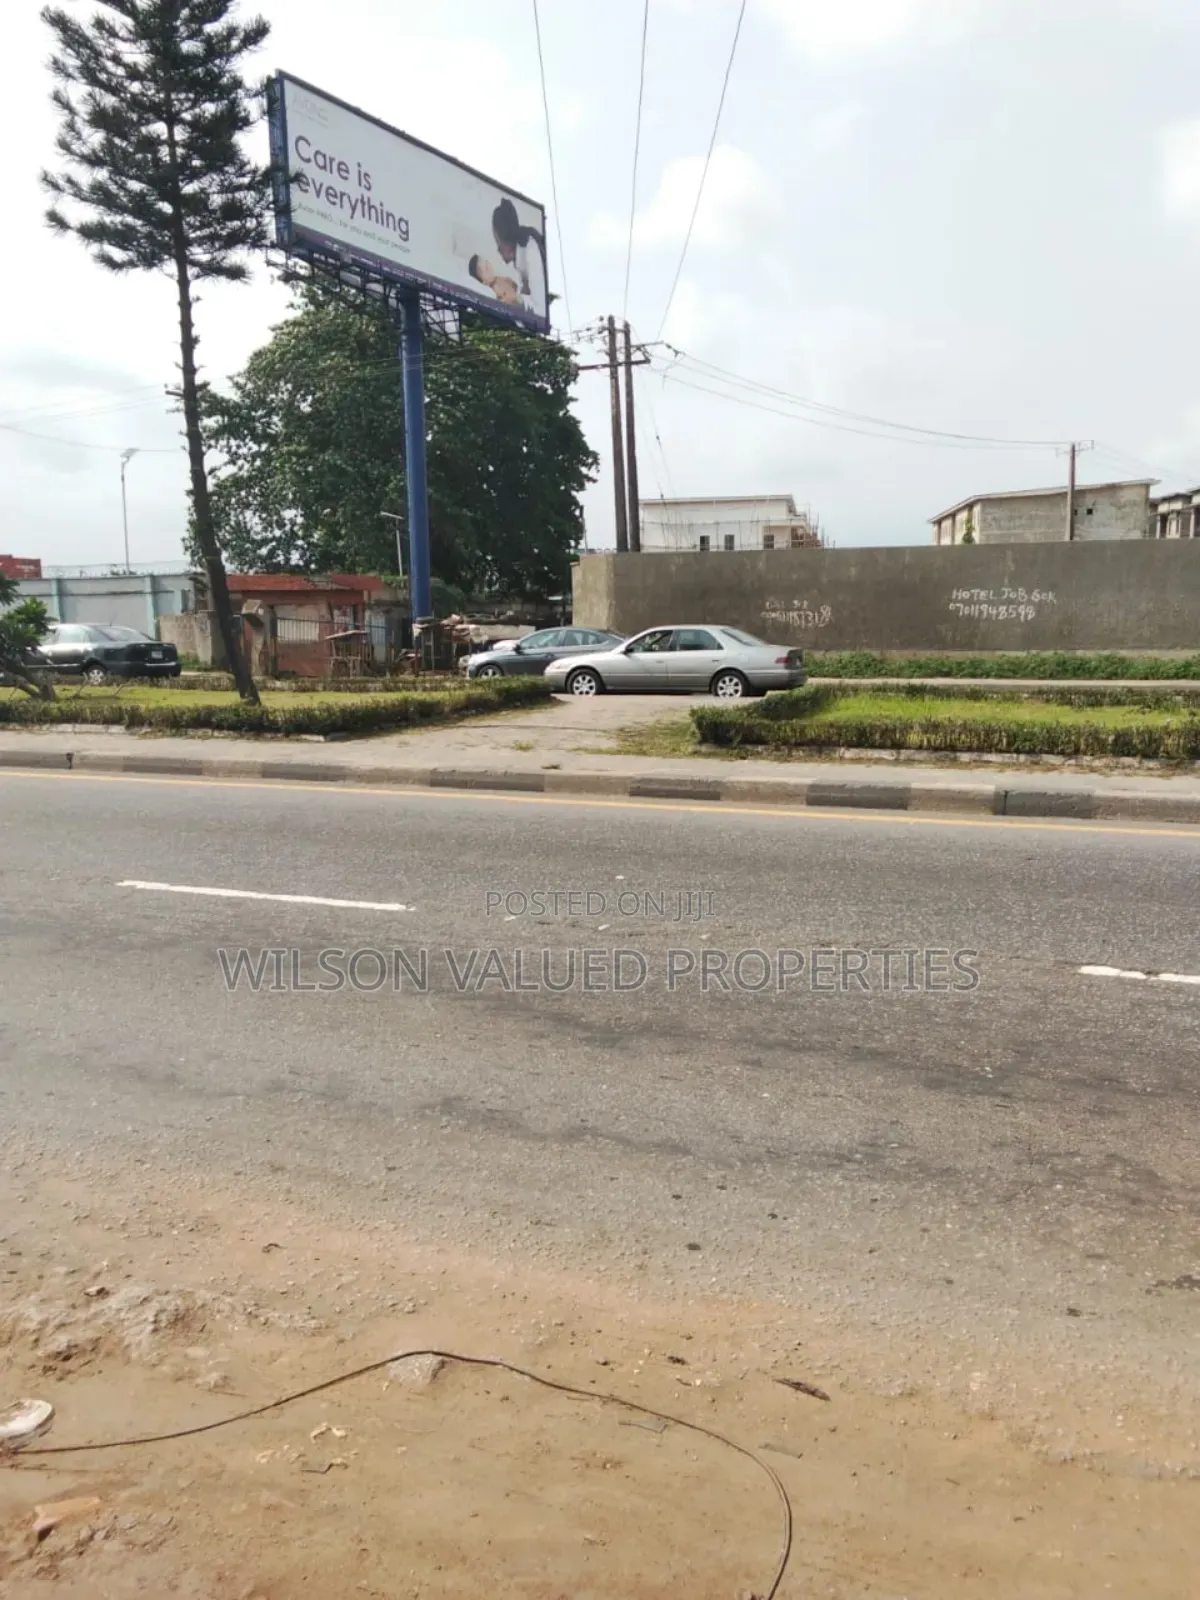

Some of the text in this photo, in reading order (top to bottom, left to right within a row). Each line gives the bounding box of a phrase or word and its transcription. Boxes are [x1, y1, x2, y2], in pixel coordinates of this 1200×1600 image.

[294, 135, 372, 192] Care is
[297, 171, 410, 242] everything
[951, 588, 997, 601] HOTEL
